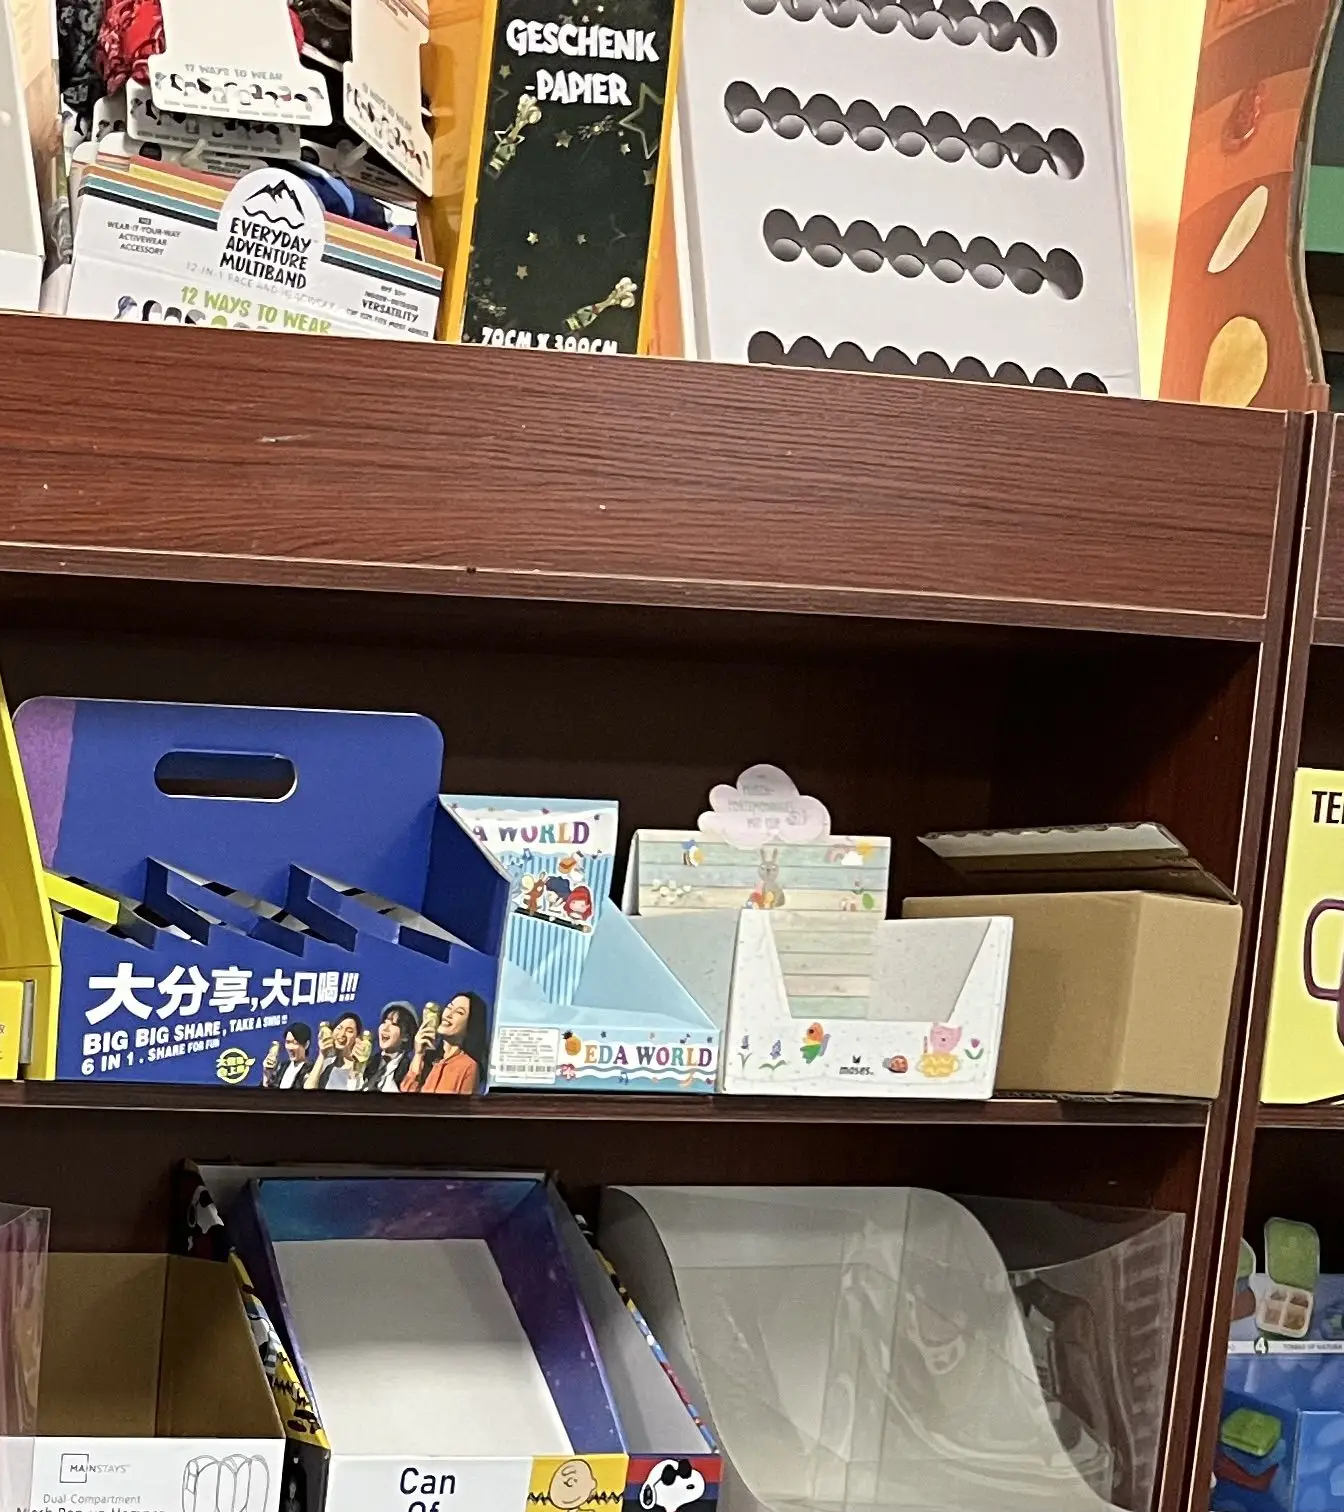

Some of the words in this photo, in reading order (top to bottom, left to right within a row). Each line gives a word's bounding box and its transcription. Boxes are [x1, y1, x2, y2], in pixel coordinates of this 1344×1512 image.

[506, 19, 660, 63] GESCHENK
[230, 217, 312, 254] EVERYDAY
[225, 236, 308, 270] ADVENTURE
[219, 252, 307, 290] MULTIBAND
[181, 285, 199, 305] 12
[203, 290, 253, 318] WAYS
[256, 303, 279, 324] TO
[283, 308, 332, 335] WEAR
[362, 299, 419, 323] VERSATILITY
[1312, 791, 1344, 825] TE
[82, 1031, 129, 1056] BIG
[134, 1026, 170, 1048] BIG
[229, 1017, 256, 1033] TAKE
[255, 1016, 262, 1029] A
[81, 1058, 95, 1076] 6
[101, 1053, 121, 1072] IN
[147, 1045, 186, 1062] SHARE
[186, 1041, 205, 1055] FOR
[635, 1045, 713, 1067] WORLD
[69, 1463, 128, 1474] MAINSTAYS
[399, 1467, 457, 1496] Can
